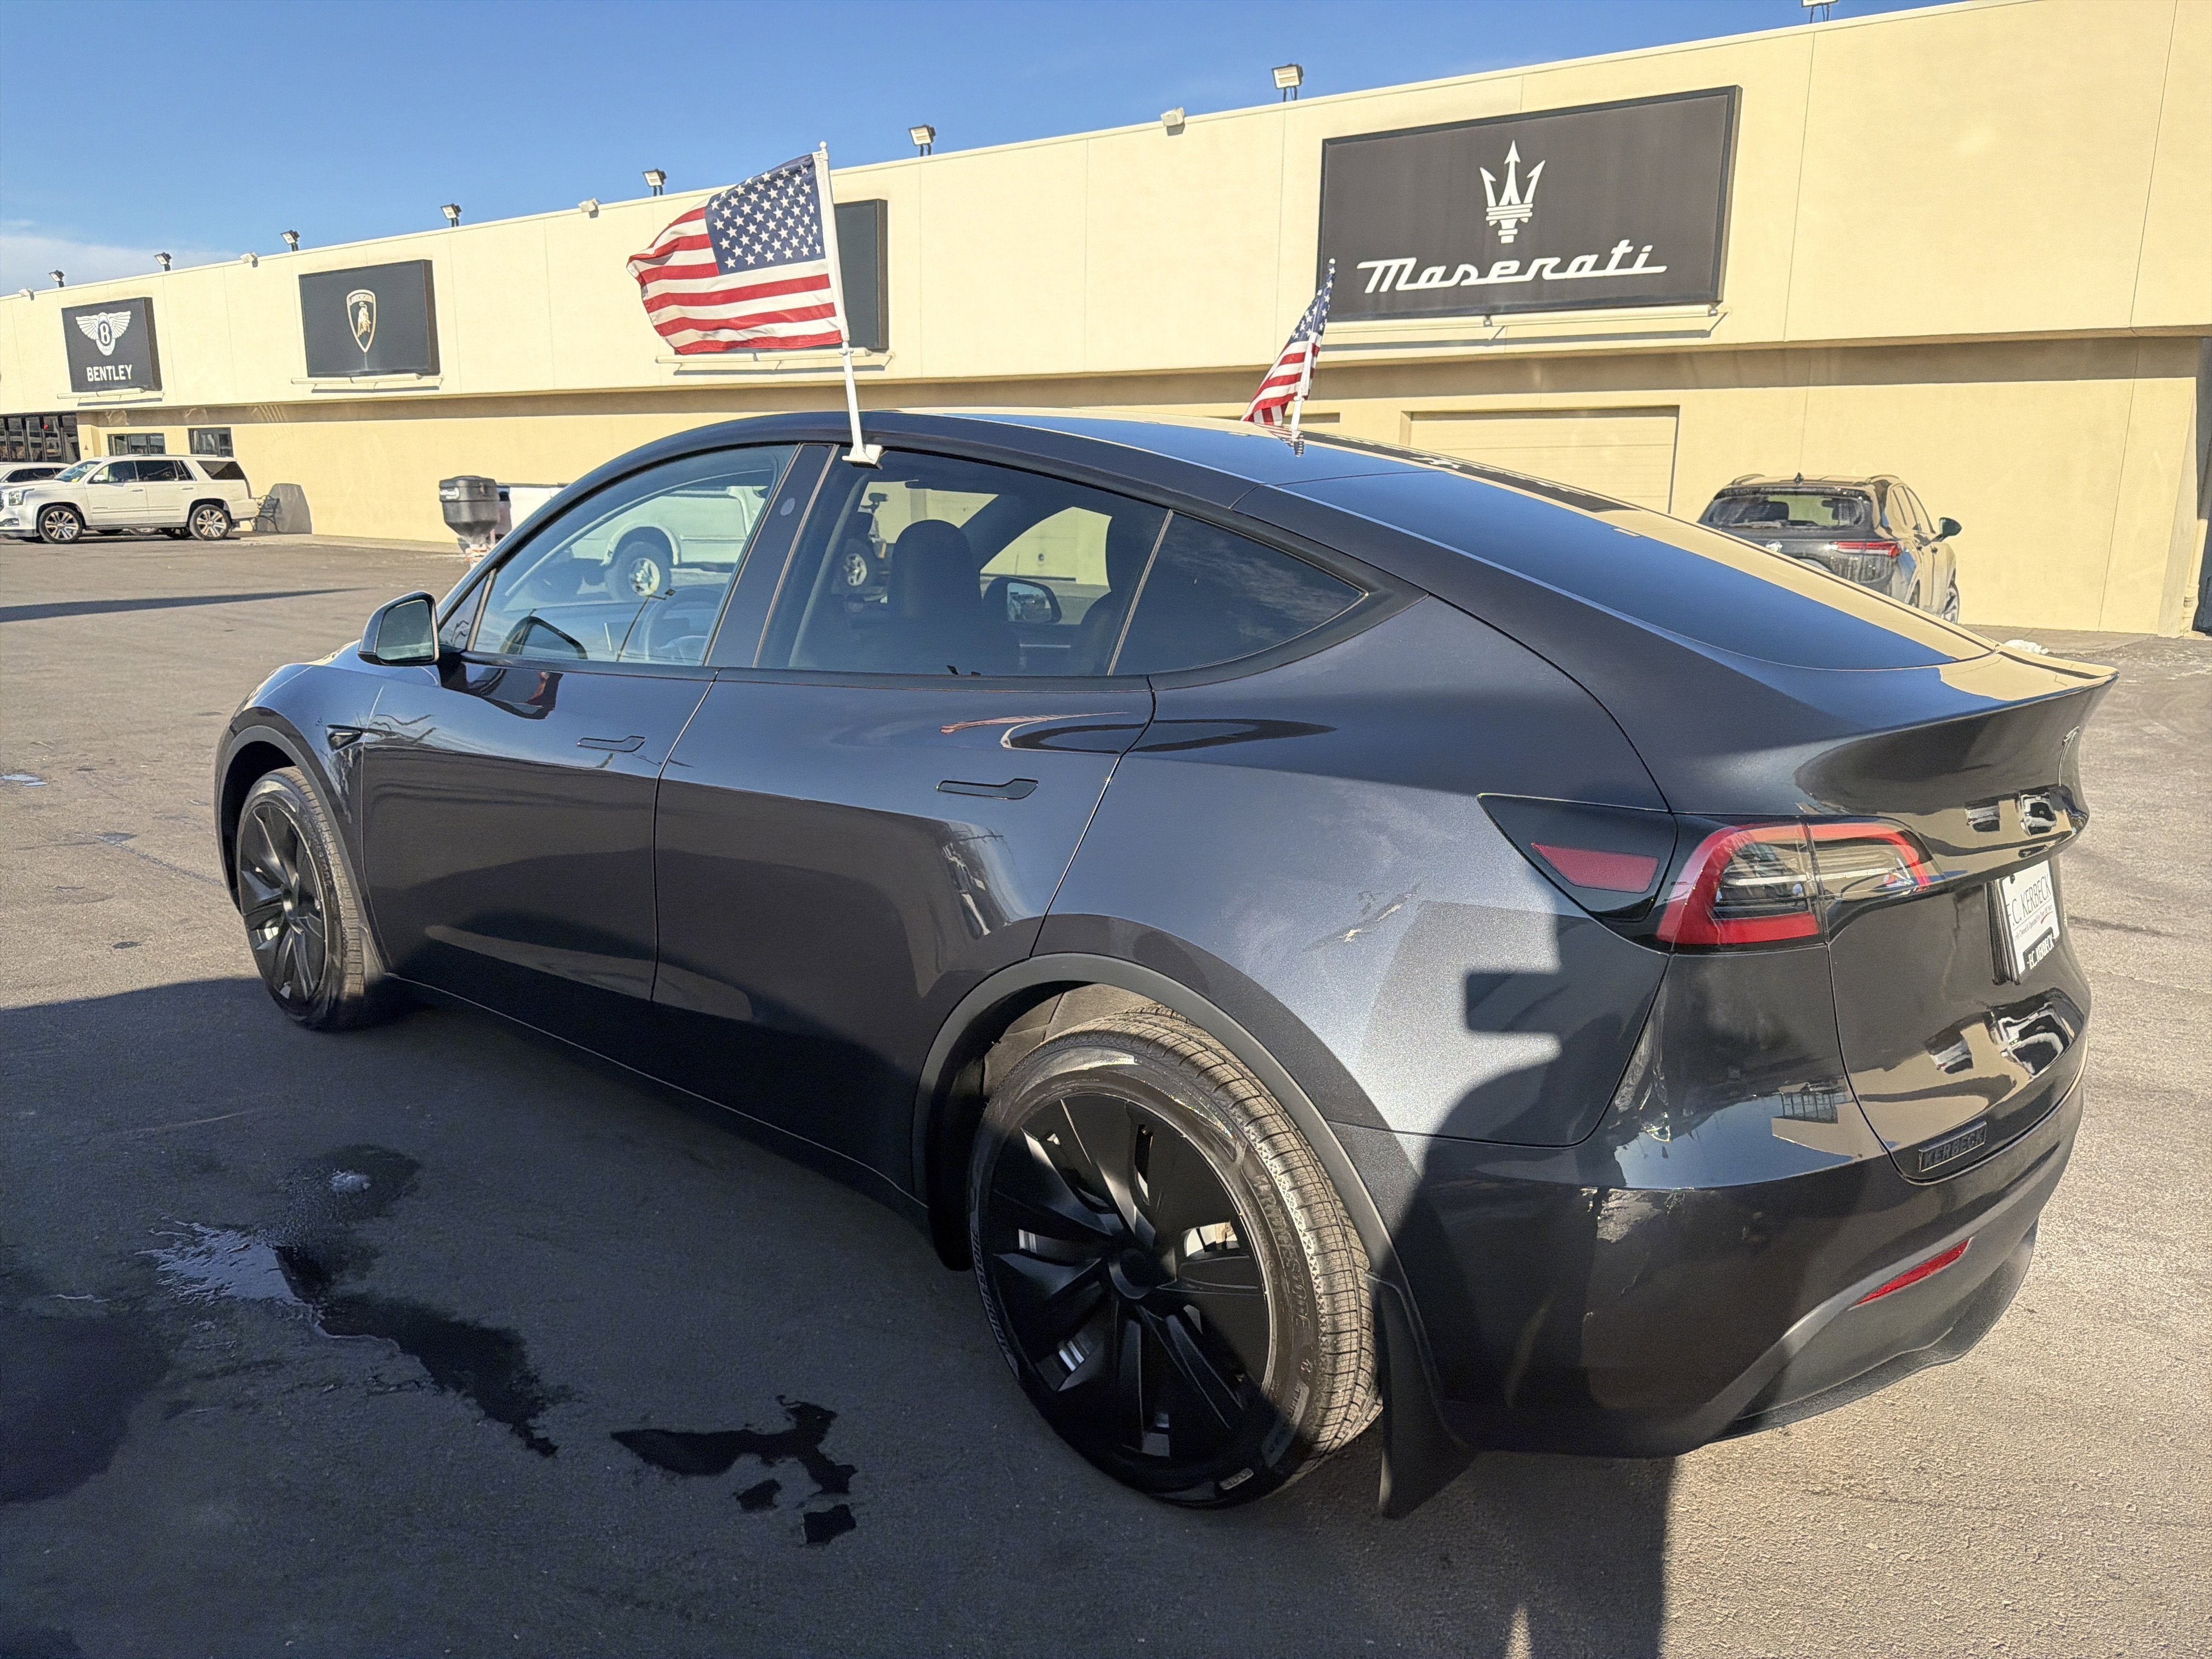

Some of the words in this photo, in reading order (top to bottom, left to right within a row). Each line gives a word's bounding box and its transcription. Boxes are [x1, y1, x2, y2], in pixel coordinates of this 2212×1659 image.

[1357, 239, 1668, 294] Maserati
[86, 364, 132, 382] BENTLEY
[2021, 874, 2051, 917] KERBECK
